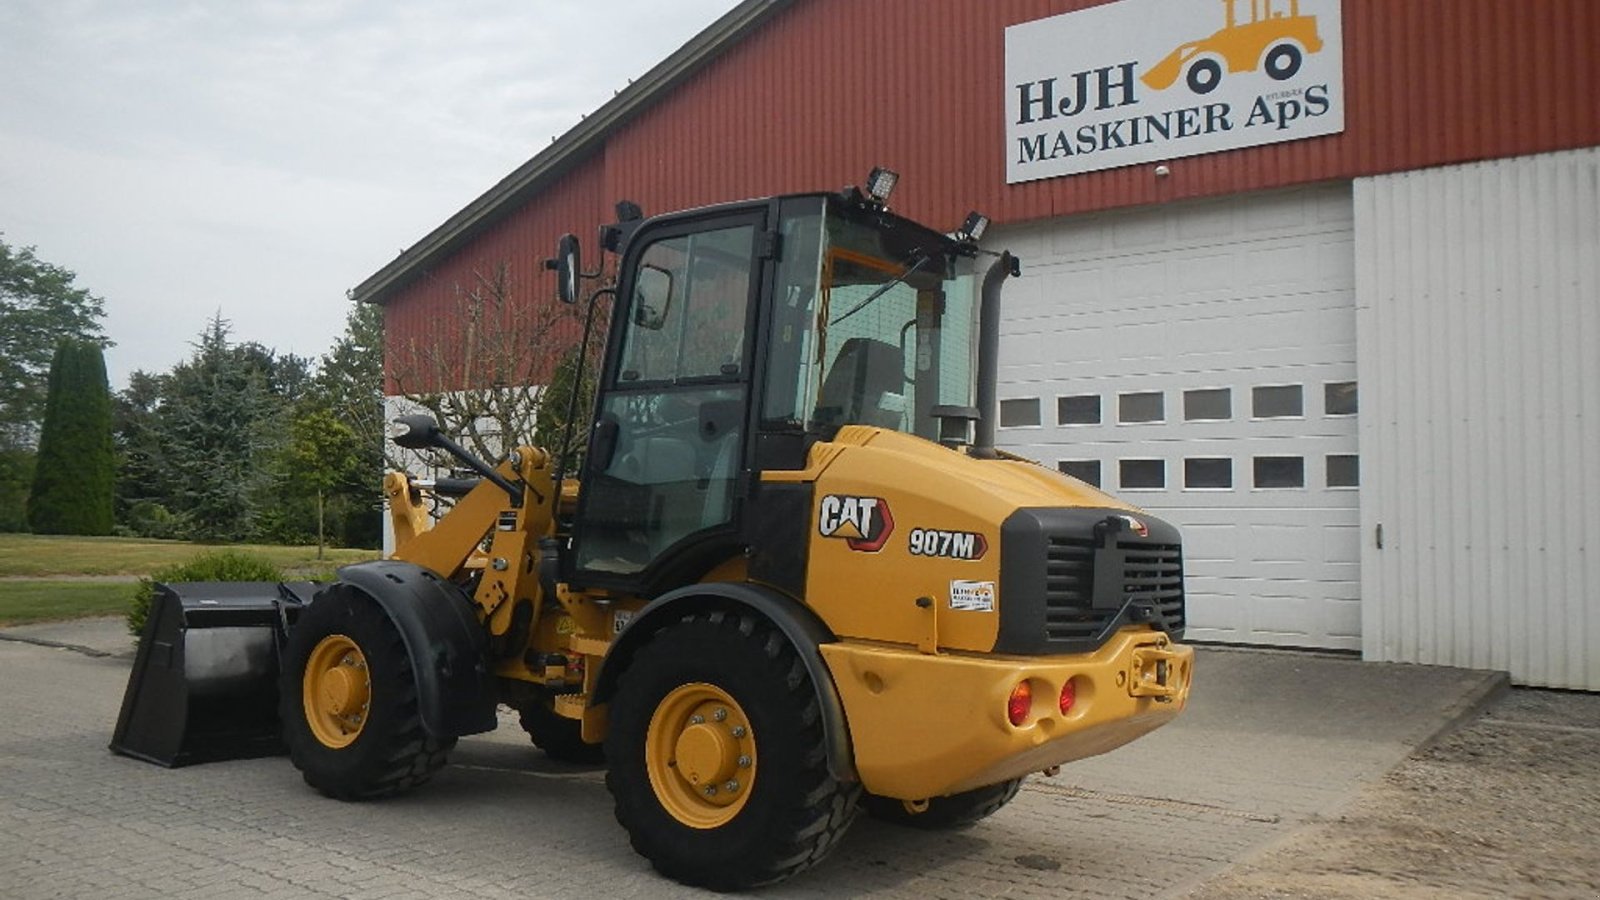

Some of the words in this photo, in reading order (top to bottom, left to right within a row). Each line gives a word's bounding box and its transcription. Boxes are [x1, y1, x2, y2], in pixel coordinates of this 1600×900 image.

[1015, 61, 1139, 125] HJH
[1017, 102, 1234, 164] MASKINER
[1244, 84, 1330, 130] ApS
[820, 495, 877, 539] CAT
[910, 529, 975, 559] 907M
